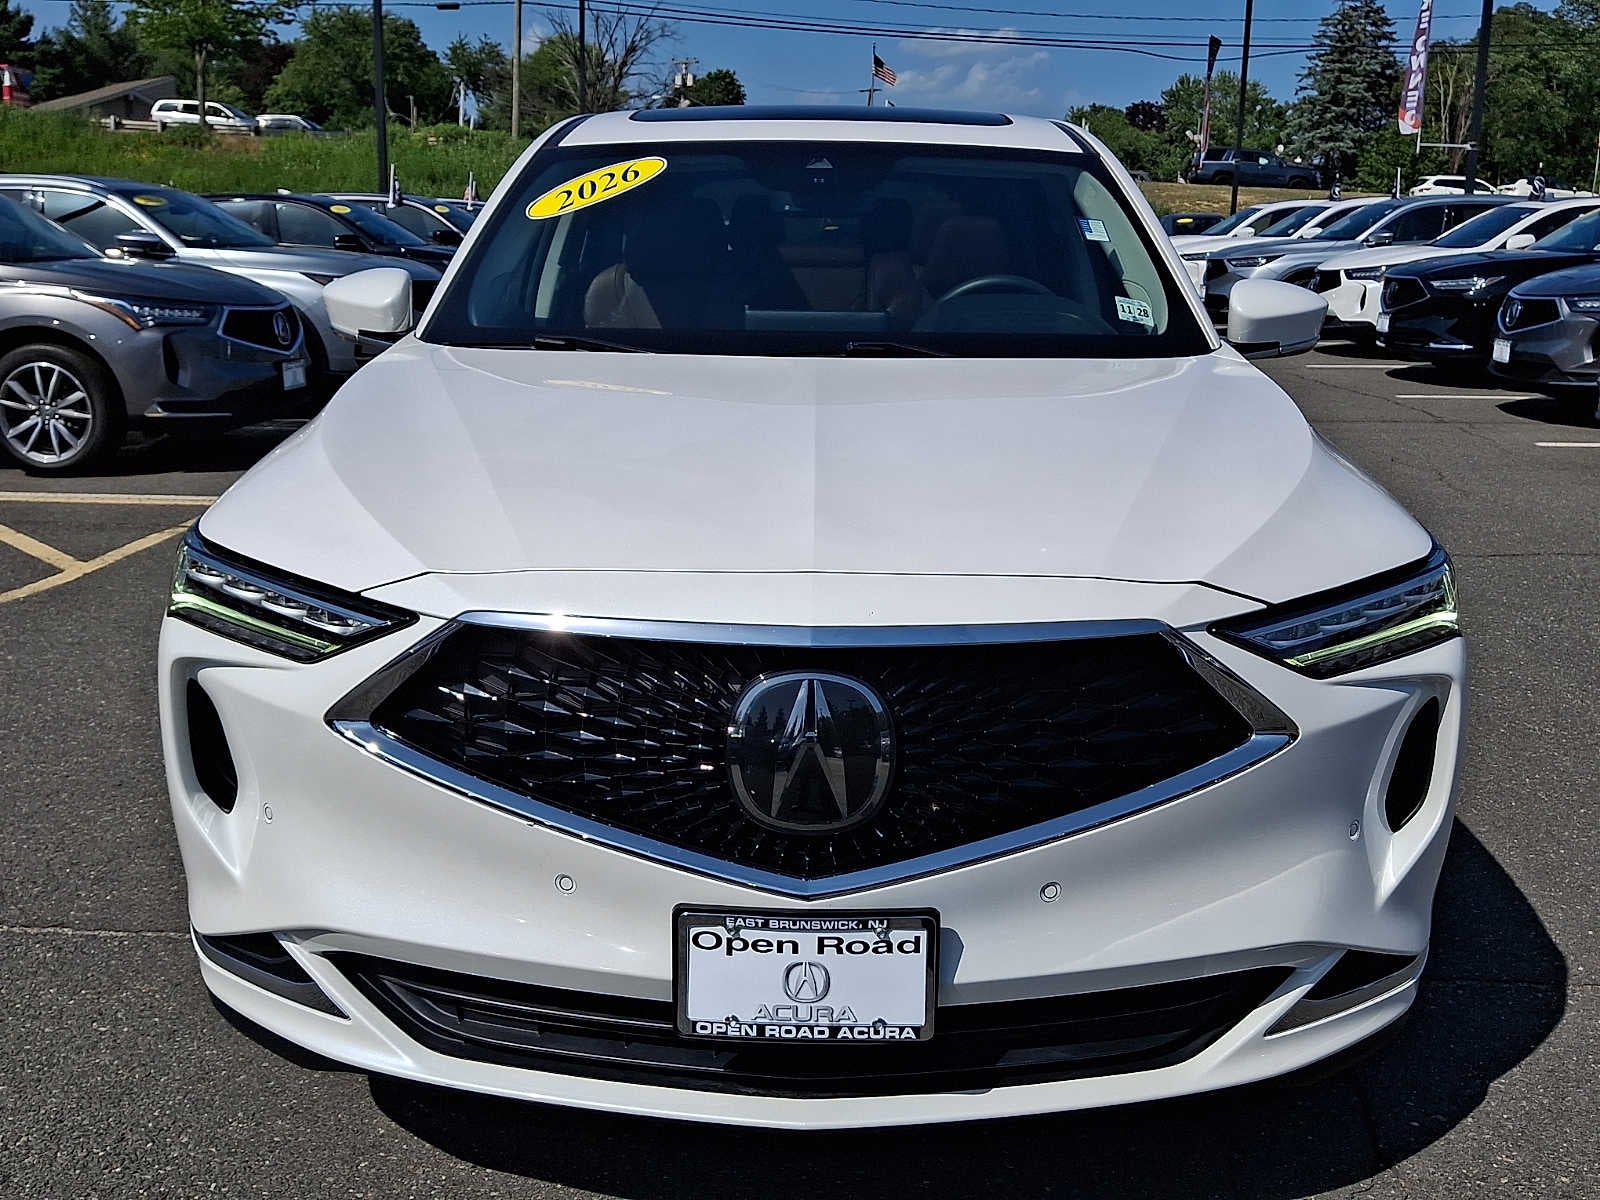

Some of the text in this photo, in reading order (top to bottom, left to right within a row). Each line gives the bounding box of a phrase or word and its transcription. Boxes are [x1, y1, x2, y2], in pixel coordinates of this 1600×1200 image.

[555, 163, 640, 211] 2026
[726, 917, 764, 928] EAST
[868, 920, 888, 930] NJ
[691, 930, 921, 956] Open Road
[751, 1003, 858, 1023] ACURA
[695, 1021, 917, 1040] OPEN ROAD ACURA
